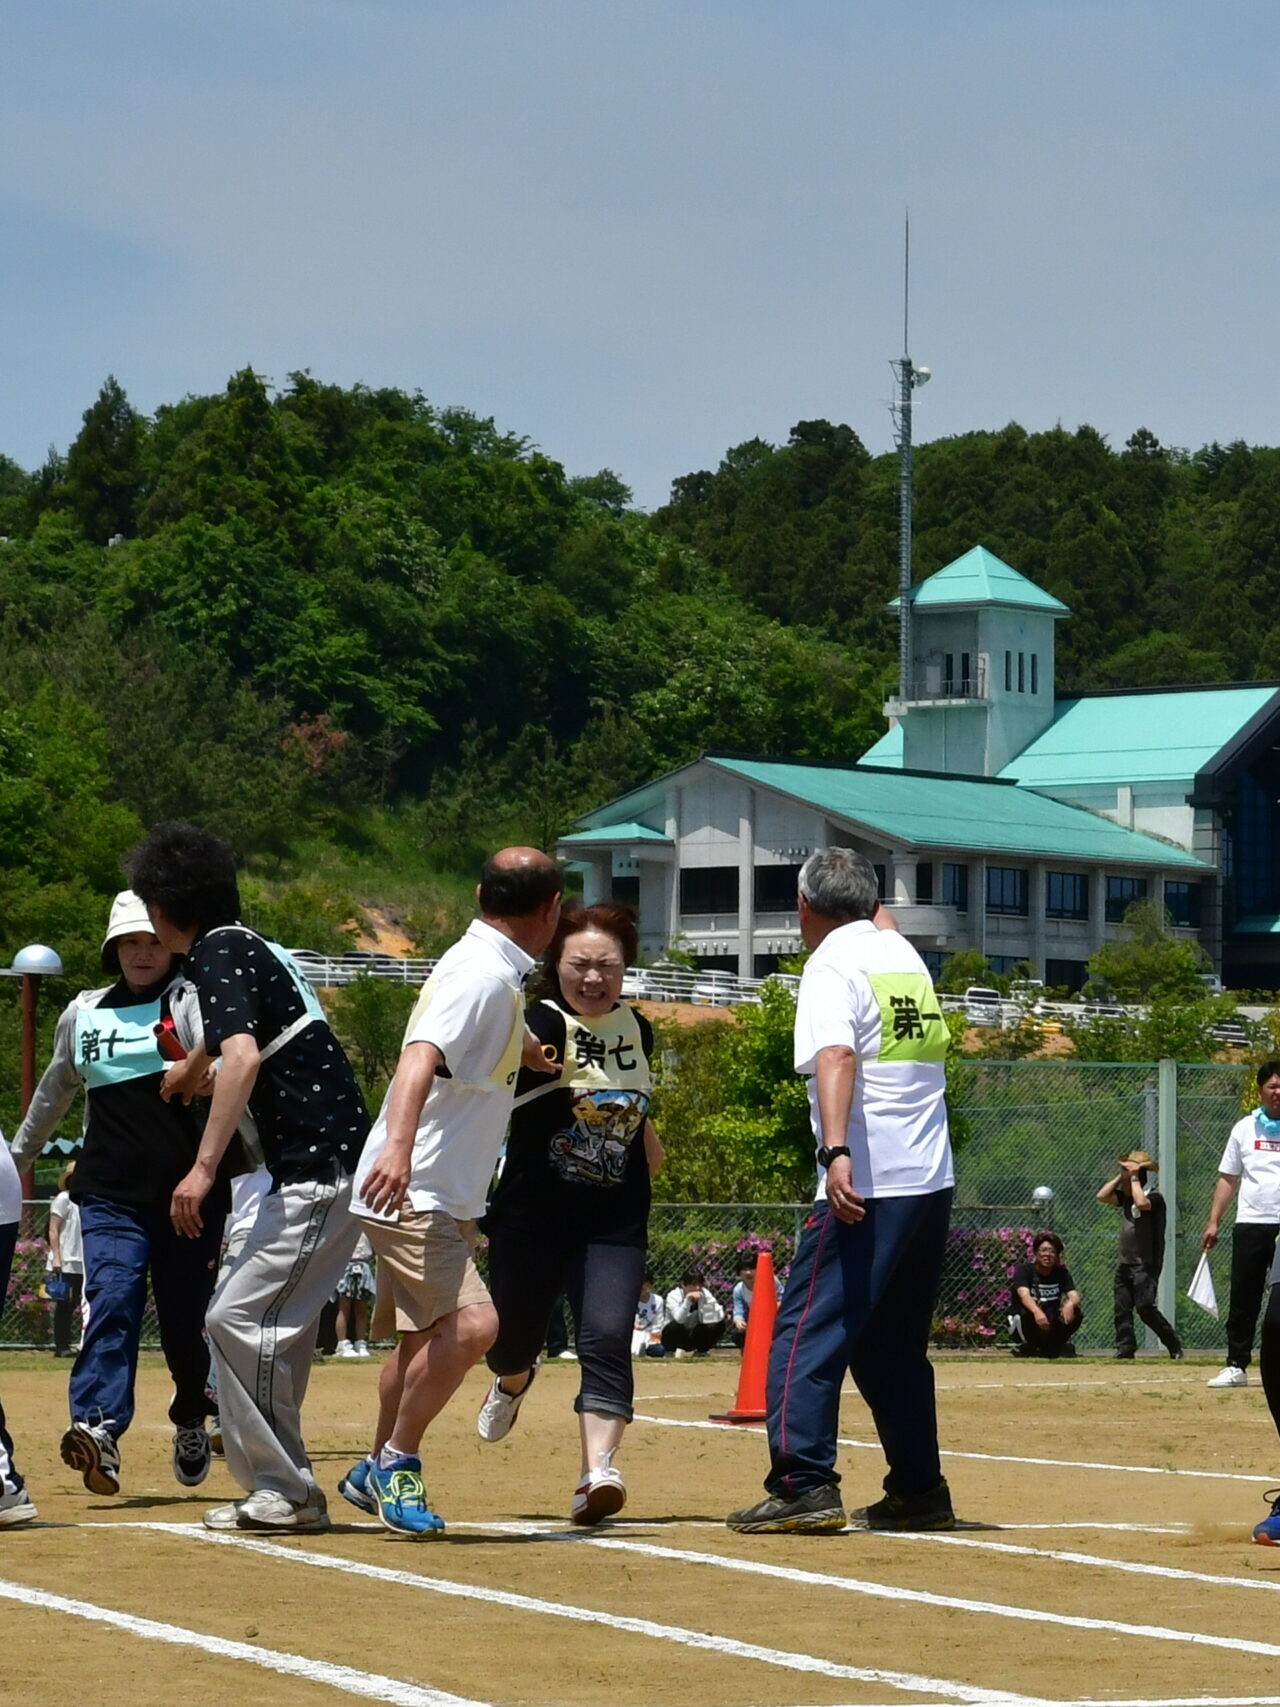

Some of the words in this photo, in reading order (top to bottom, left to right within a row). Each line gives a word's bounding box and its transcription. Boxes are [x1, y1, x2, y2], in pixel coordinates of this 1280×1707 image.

[889, 994, 941, 1041] 第一
[80, 1028, 149, 1065] 第十一
[574, 1028, 637, 1071] 第七
